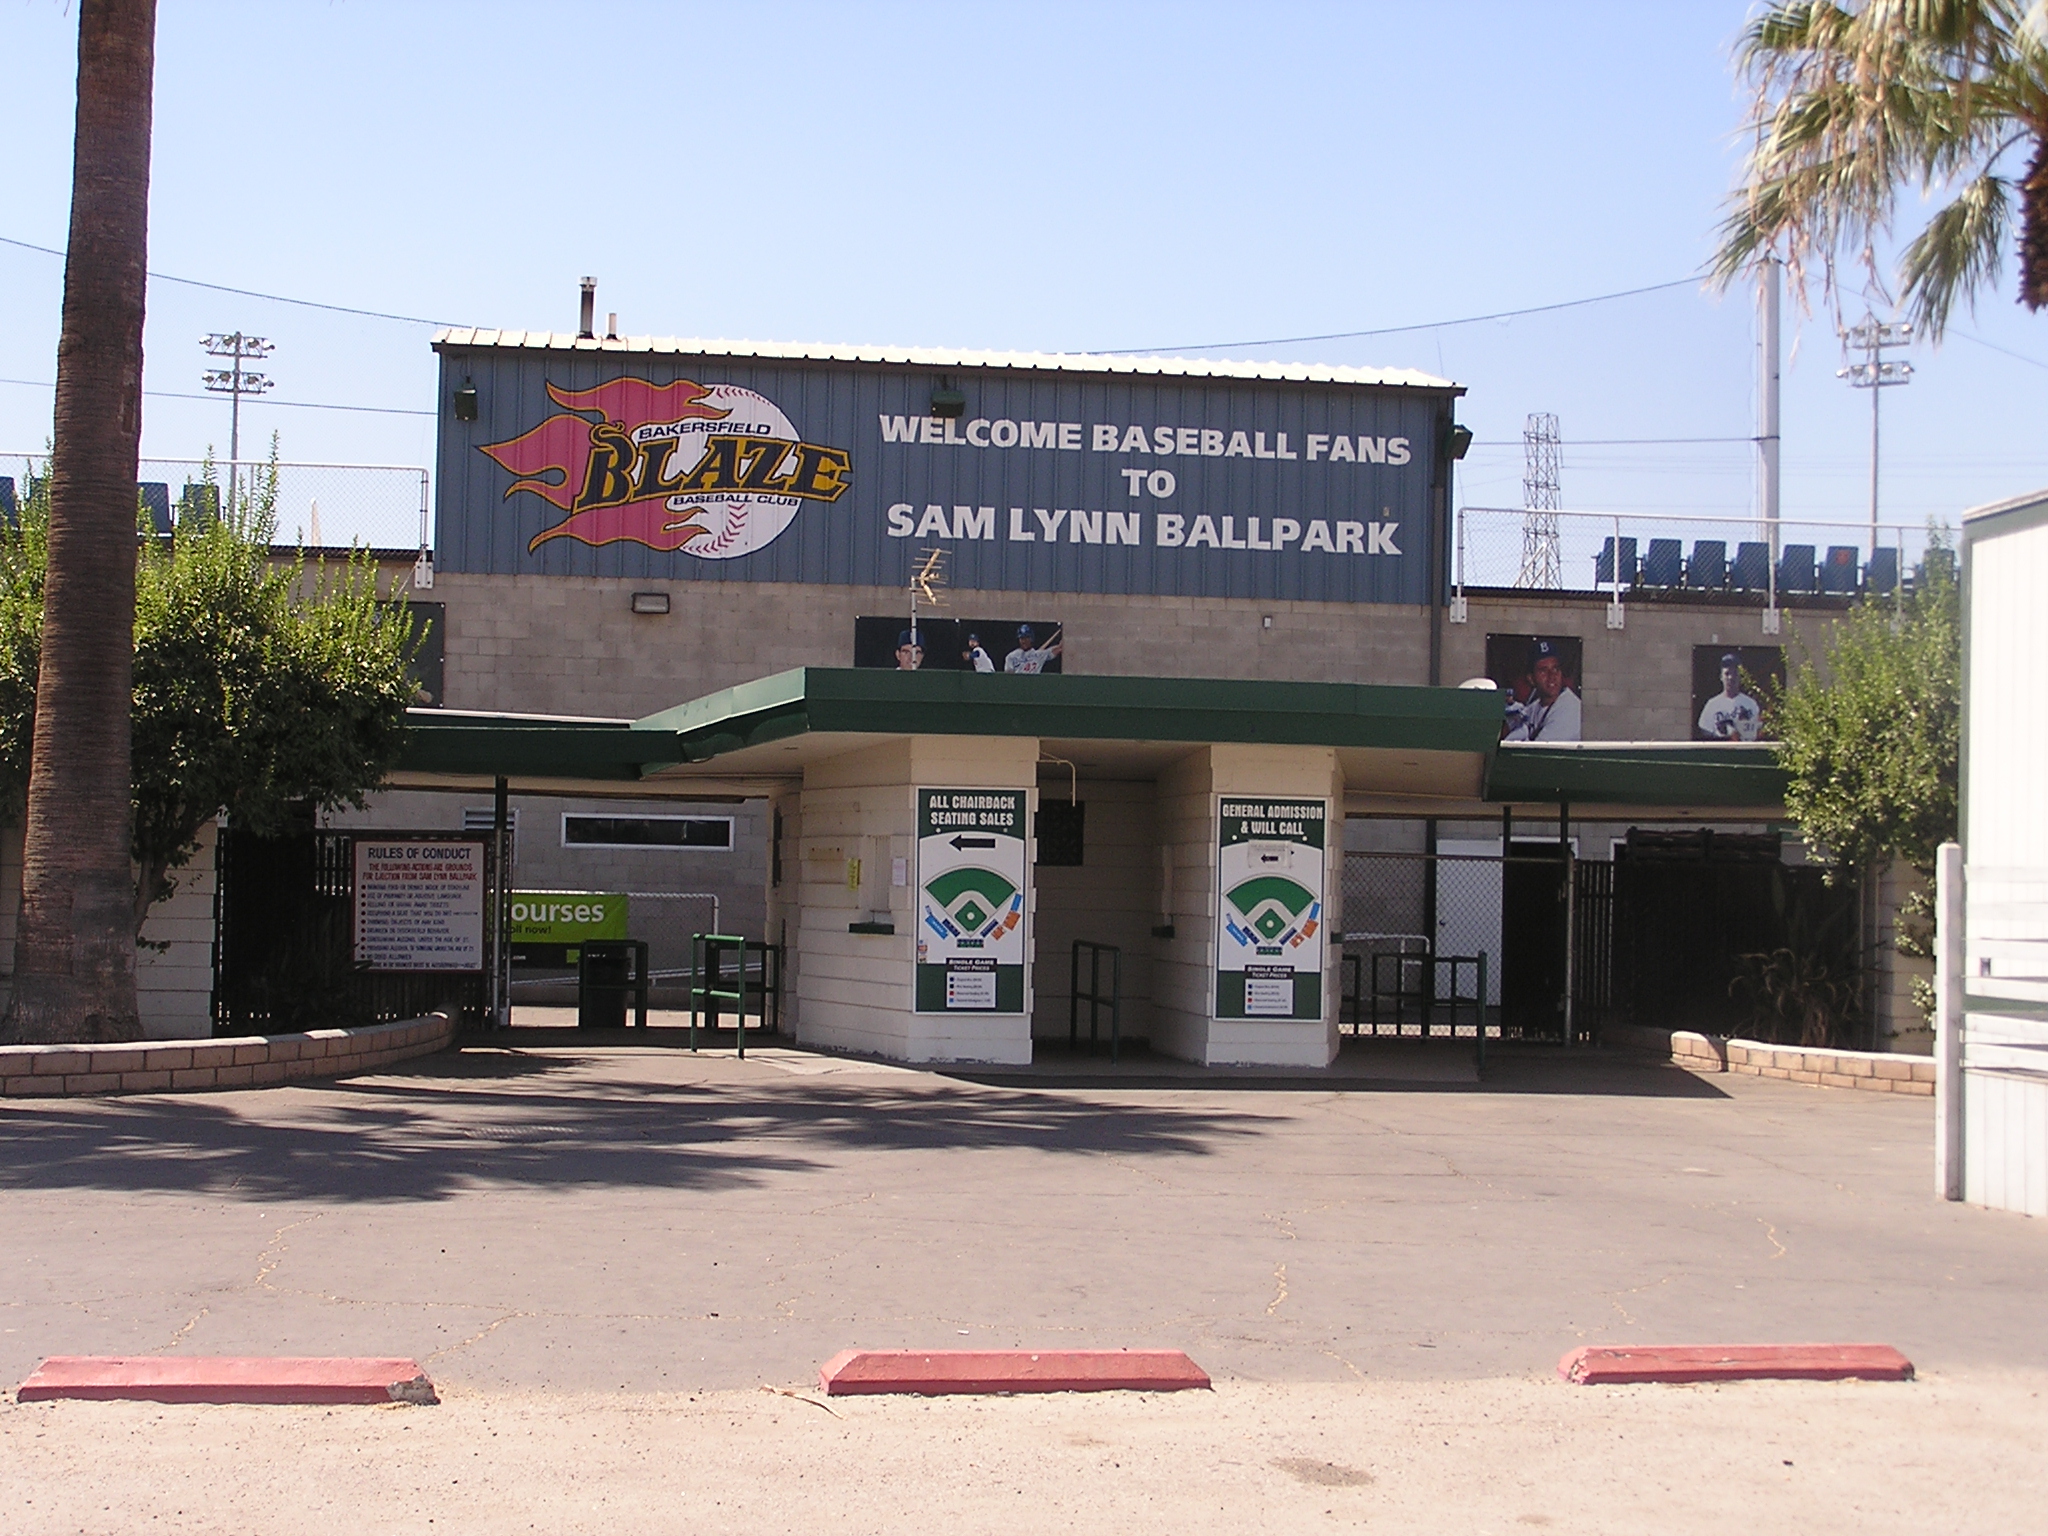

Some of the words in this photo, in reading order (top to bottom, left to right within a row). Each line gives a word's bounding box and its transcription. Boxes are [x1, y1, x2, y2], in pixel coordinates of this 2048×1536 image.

[638, 421, 771, 440] BAKERSFIELD
[879, 413, 1082, 451] WELCOME
[1092, 423, 1297, 460] BASEBALL
[1306, 433, 1412, 466] FANS
[571, 420, 853, 515] BLAZE
[1121, 468, 1177, 499] TO
[673, 492, 753, 506] BASEBALL
[756, 495, 799, 507] CLUB
[887, 503, 995, 540] SAM
[1009, 507, 1141, 546] LYNN
[1157, 514, 1403, 555] BALLPARK
[929, 795, 950, 809] ALL
[952, 796, 1015, 810] CHAIRBACK
[930, 811, 977, 826] SEATING
[979, 813, 1014, 826] SALES
[1222, 804, 1265, 818] GENERAL
[1267, 805, 1323, 819] ADMISSION
[1240, 821, 1249, 834] &
[1251, 821, 1277, 835] WILL
[1279, 822, 1304, 835] CALL
[368, 848, 403, 859] RULES
[407, 848, 419, 859] OF
[423, 848, 471, 859] CONDUCT
[511, 902, 604, 923] ourses
[525, 925, 552, 934] now!
